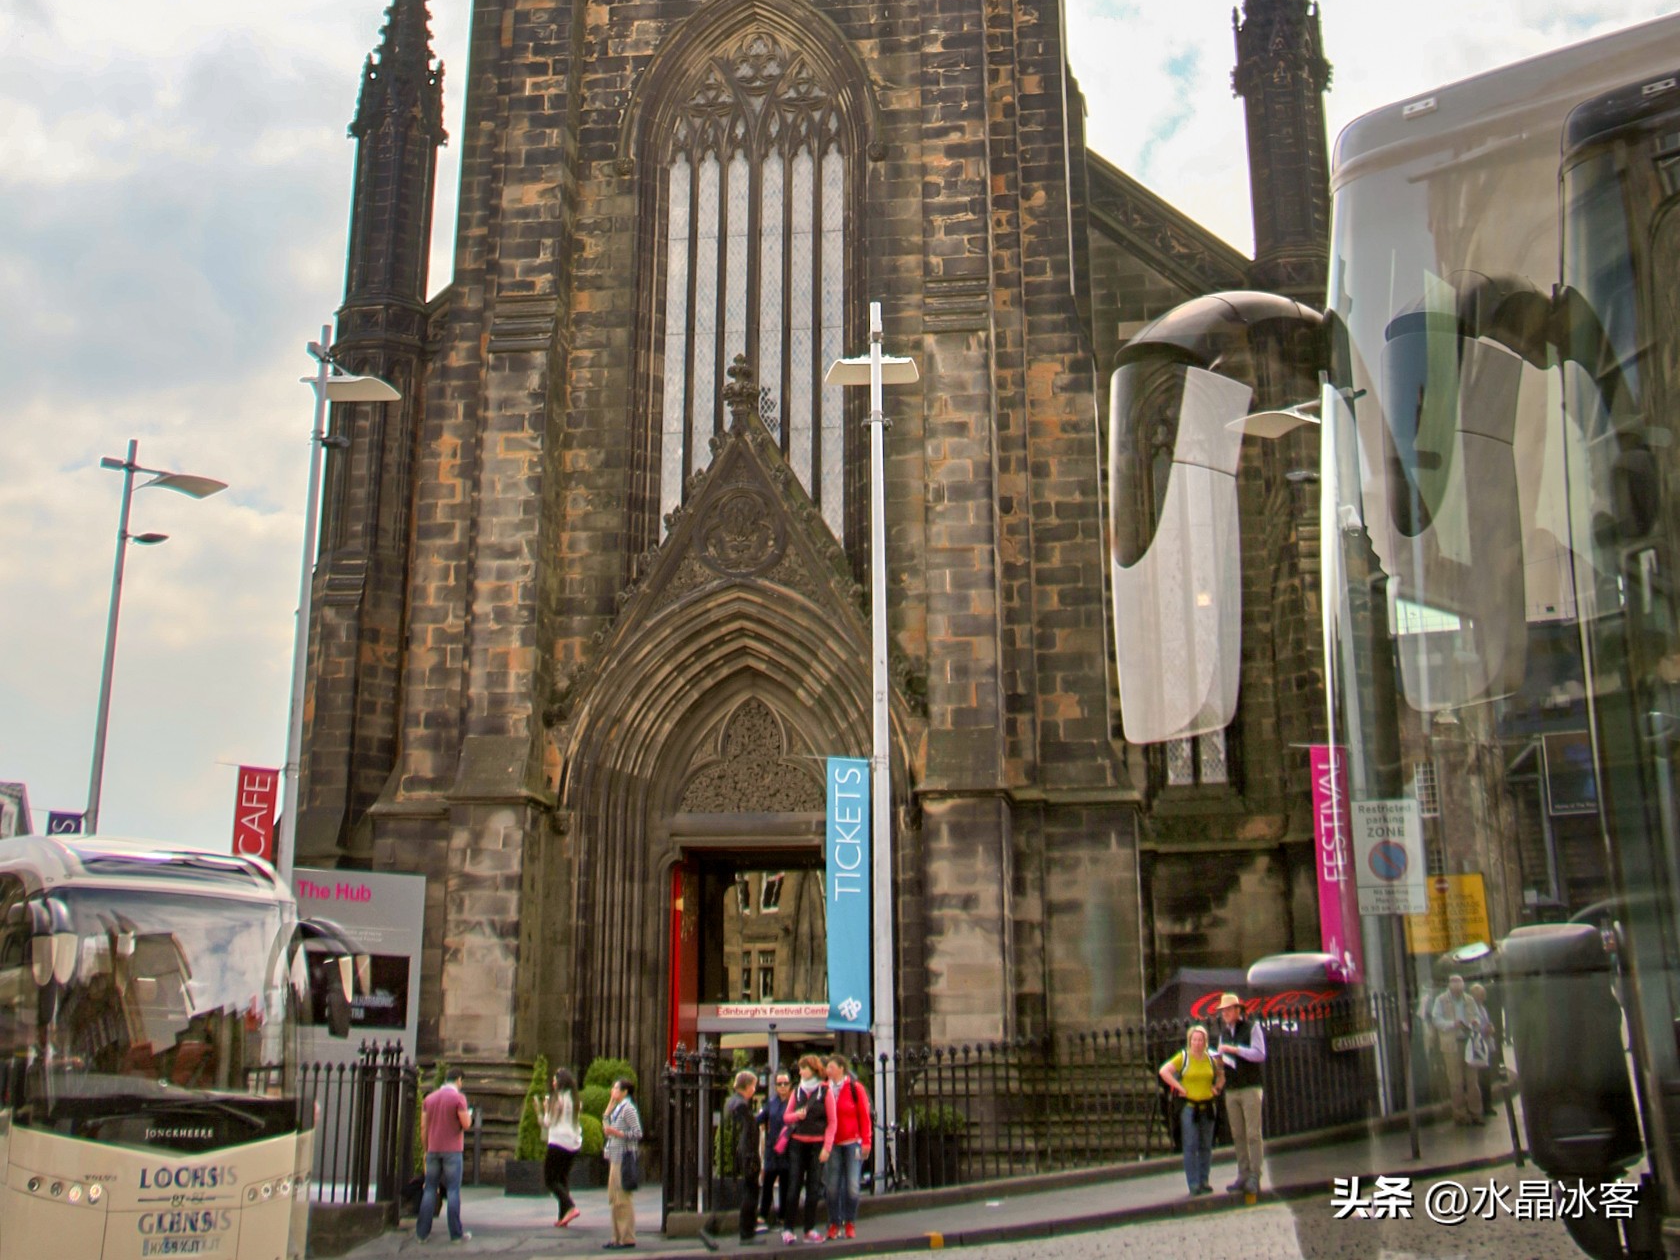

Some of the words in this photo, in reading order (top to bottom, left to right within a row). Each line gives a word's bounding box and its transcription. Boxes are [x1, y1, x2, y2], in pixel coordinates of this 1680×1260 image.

[238, 774, 271, 857] CAFE
[1318, 754, 1347, 882] FESTIVAL
[1358, 803, 1411, 814] Restricted
[1366, 815, 1404, 825] parking
[835, 768, 861, 902] TICKETS
[1367, 826, 1405, 838] ZONE
[297, 880, 330, 900] The
[335, 883, 372, 903] Hub
[717, 1006, 767, 1019] Edinburgh's
[769, 1006, 802, 1016] Festival
[804, 1007, 829, 1017] Centr
[1190, 990, 1342, 1022] Coa-Cola
[144, 1127, 214, 1140] JONCKHEERE
[139, 1166, 220, 1190] LOCHS
[138, 1212, 215, 1236] GLENS
